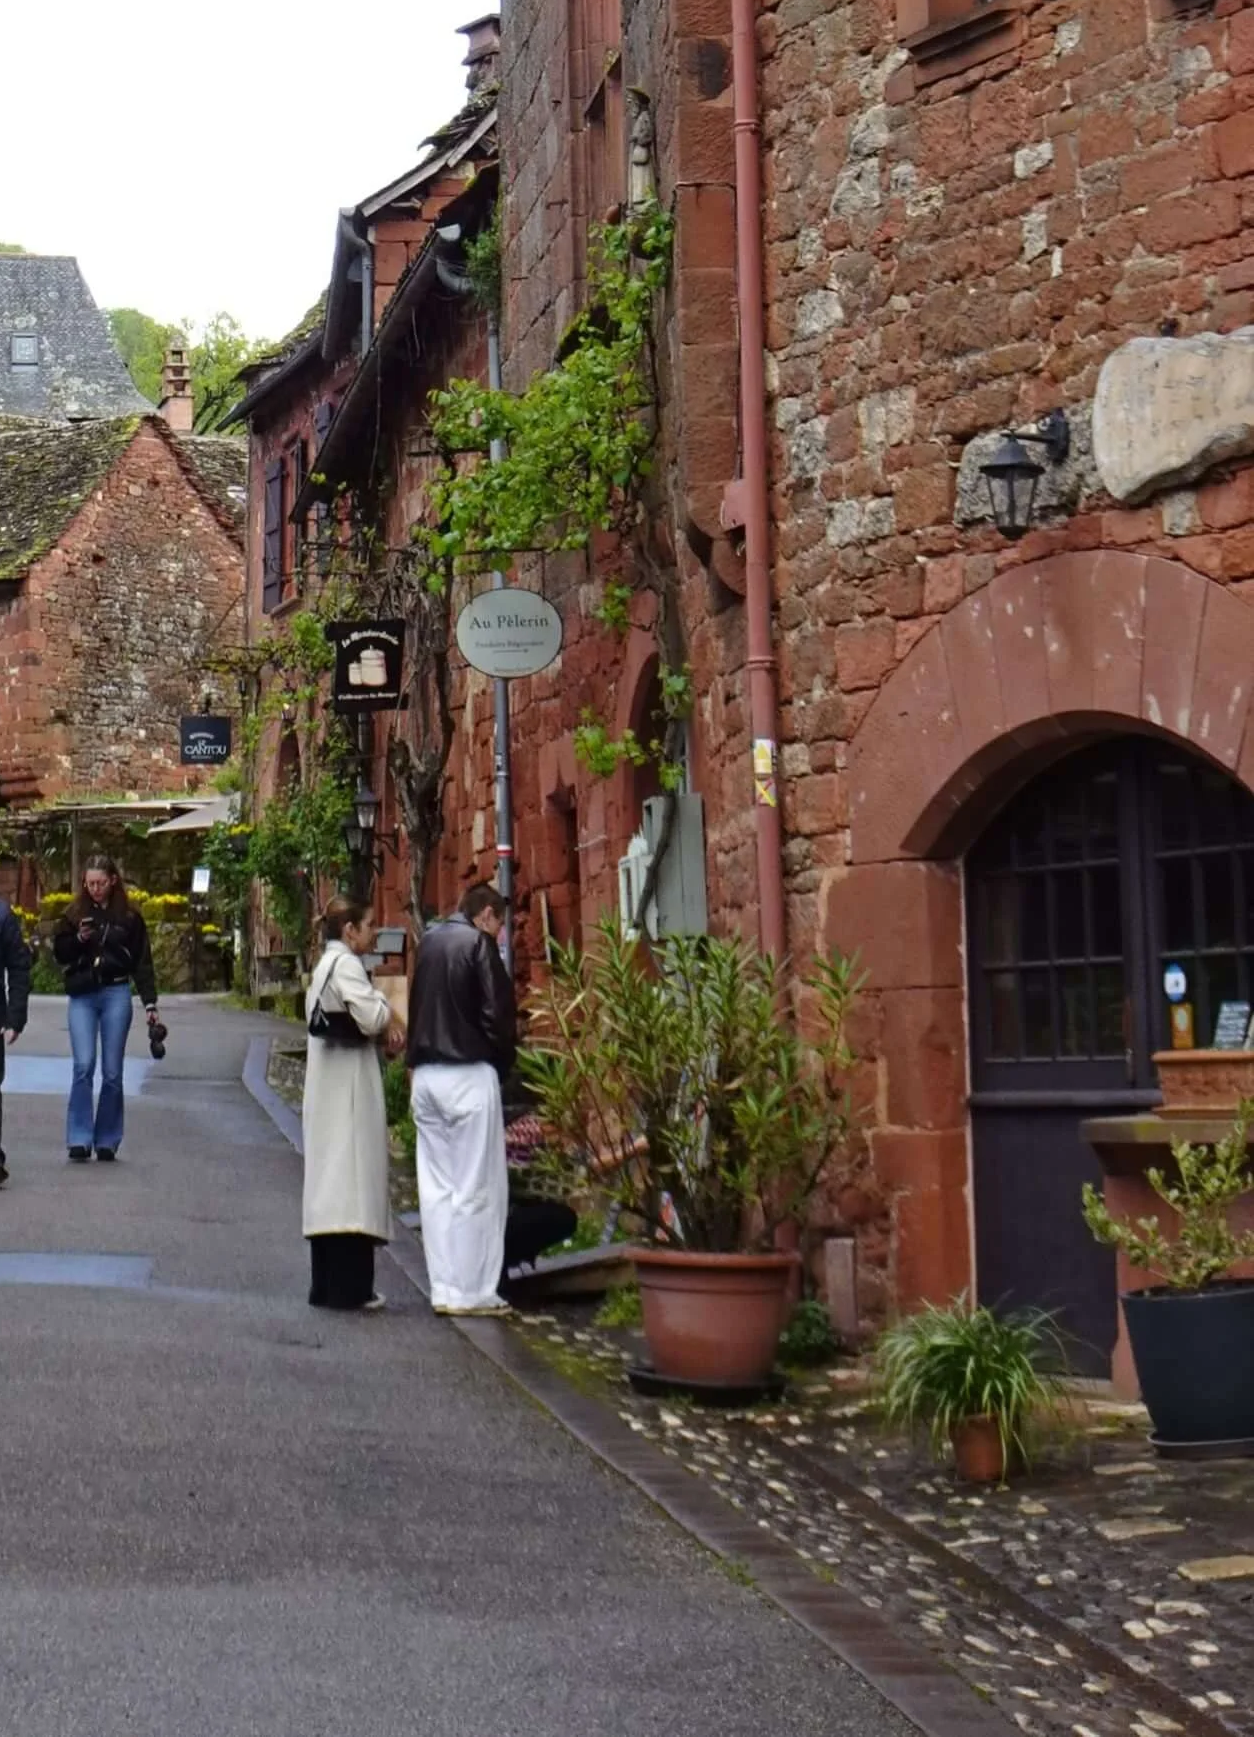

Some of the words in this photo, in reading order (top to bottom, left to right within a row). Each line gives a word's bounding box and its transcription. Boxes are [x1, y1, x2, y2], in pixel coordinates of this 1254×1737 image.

[469, 616, 491, 630] Au
[497, 614, 549, 629] Pèlerin
[185, 744, 227, 755] CANTOU
